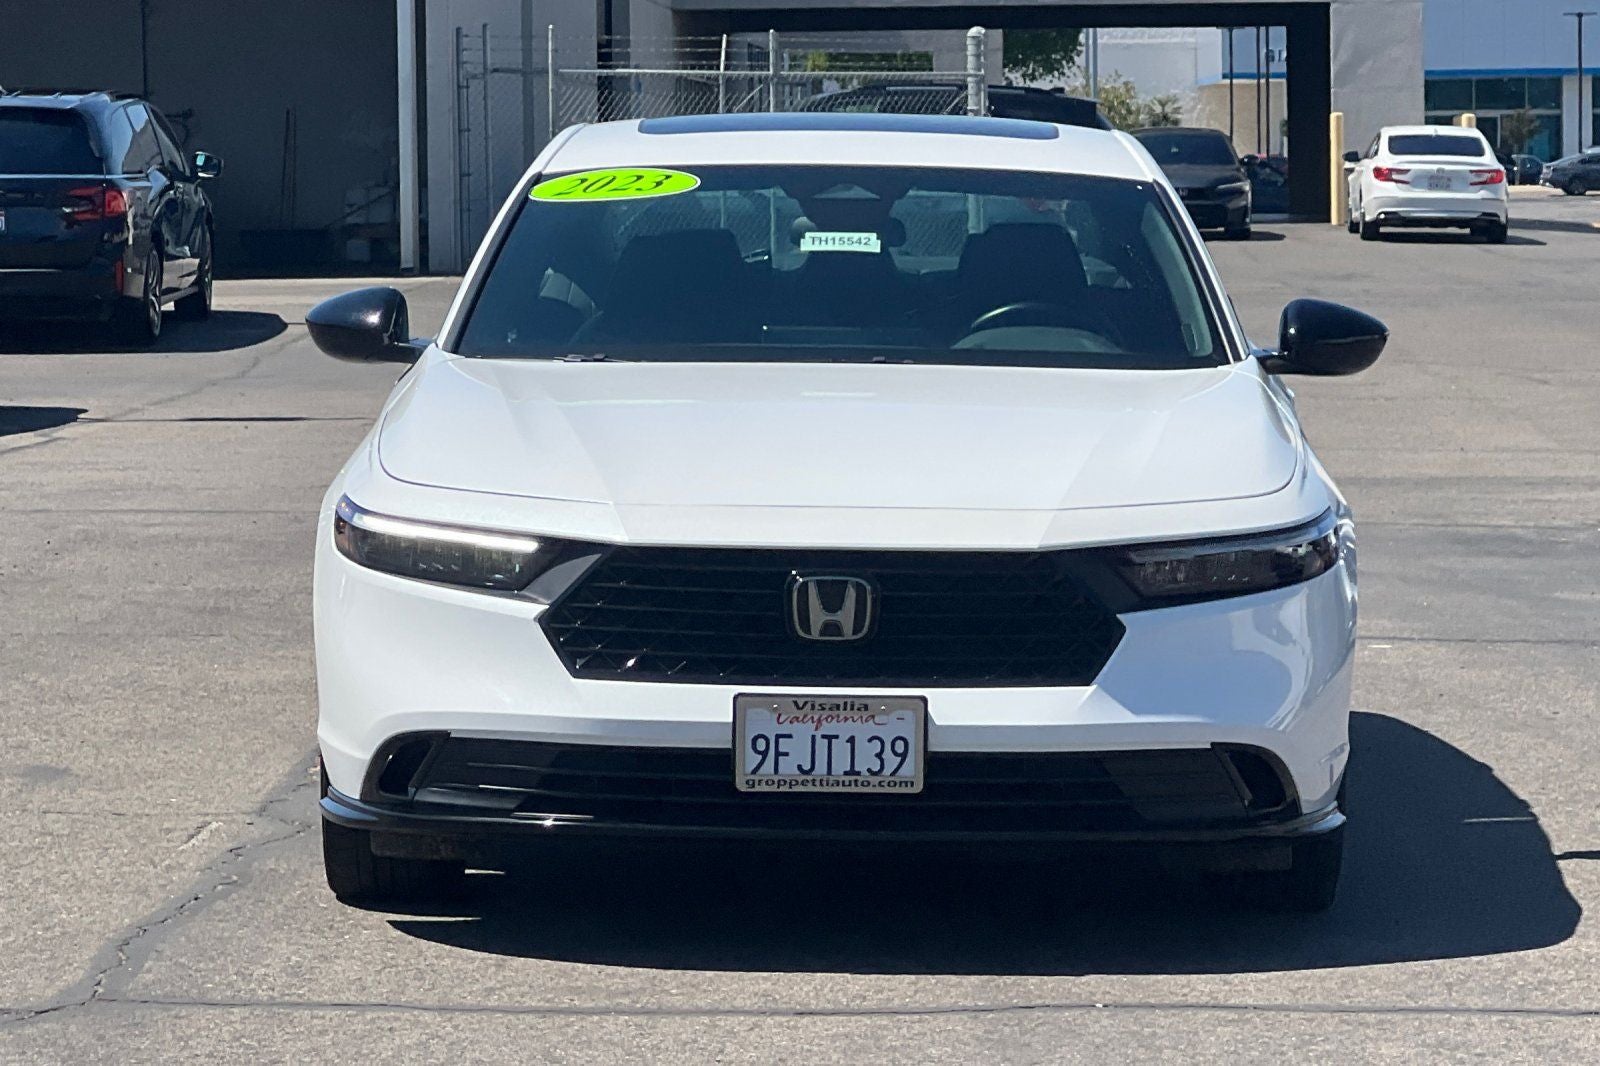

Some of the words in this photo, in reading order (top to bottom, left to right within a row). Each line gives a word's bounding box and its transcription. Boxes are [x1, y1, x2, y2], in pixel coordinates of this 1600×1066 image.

[551, 174, 673, 197] 2023
[808, 236, 871, 246] TH15542
[792, 700, 869, 712] Visalia
[750, 733, 910, 777] 9FJT139
[745, 777, 915, 789] groppettiauto.com
